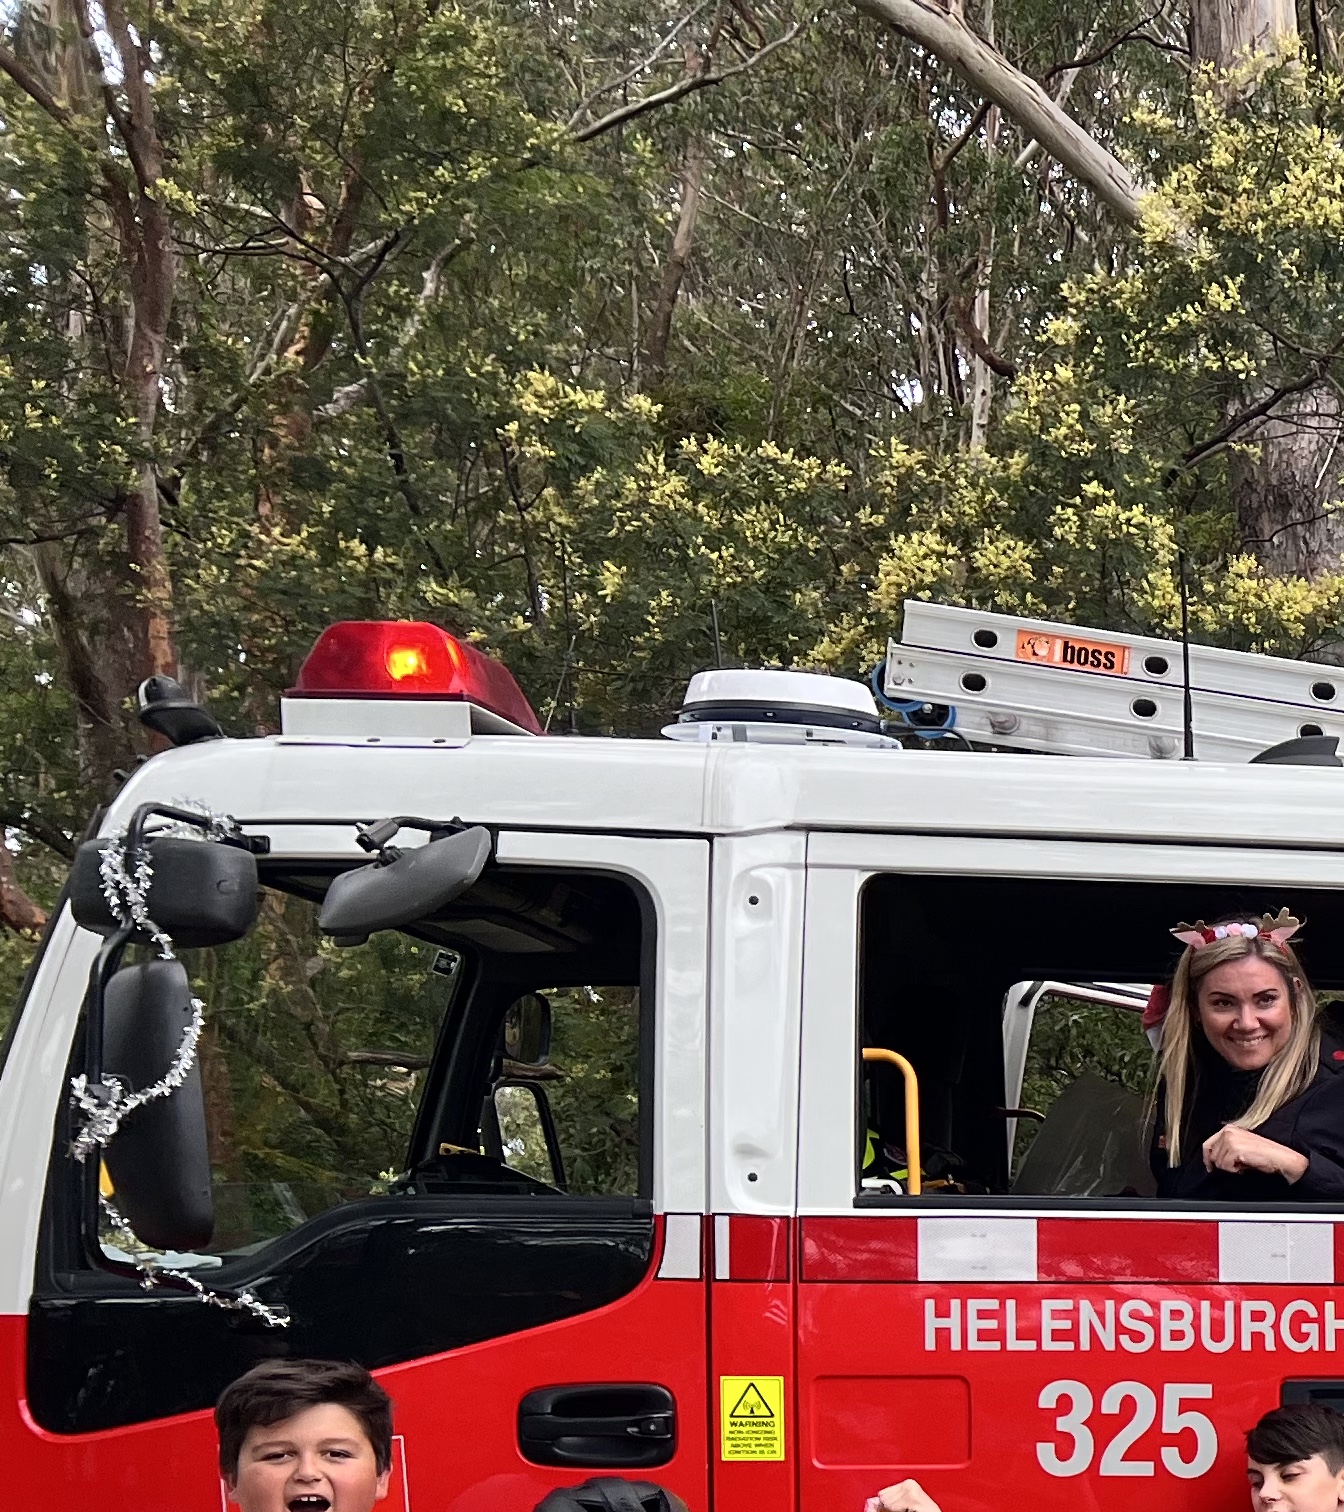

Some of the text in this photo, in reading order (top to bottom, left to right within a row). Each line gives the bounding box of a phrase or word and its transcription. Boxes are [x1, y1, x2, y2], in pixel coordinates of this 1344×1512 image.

[1061, 640, 1116, 670] boss
[729, 1420, 776, 1428] WARNING
[1036, 1379, 1219, 1478] 325
